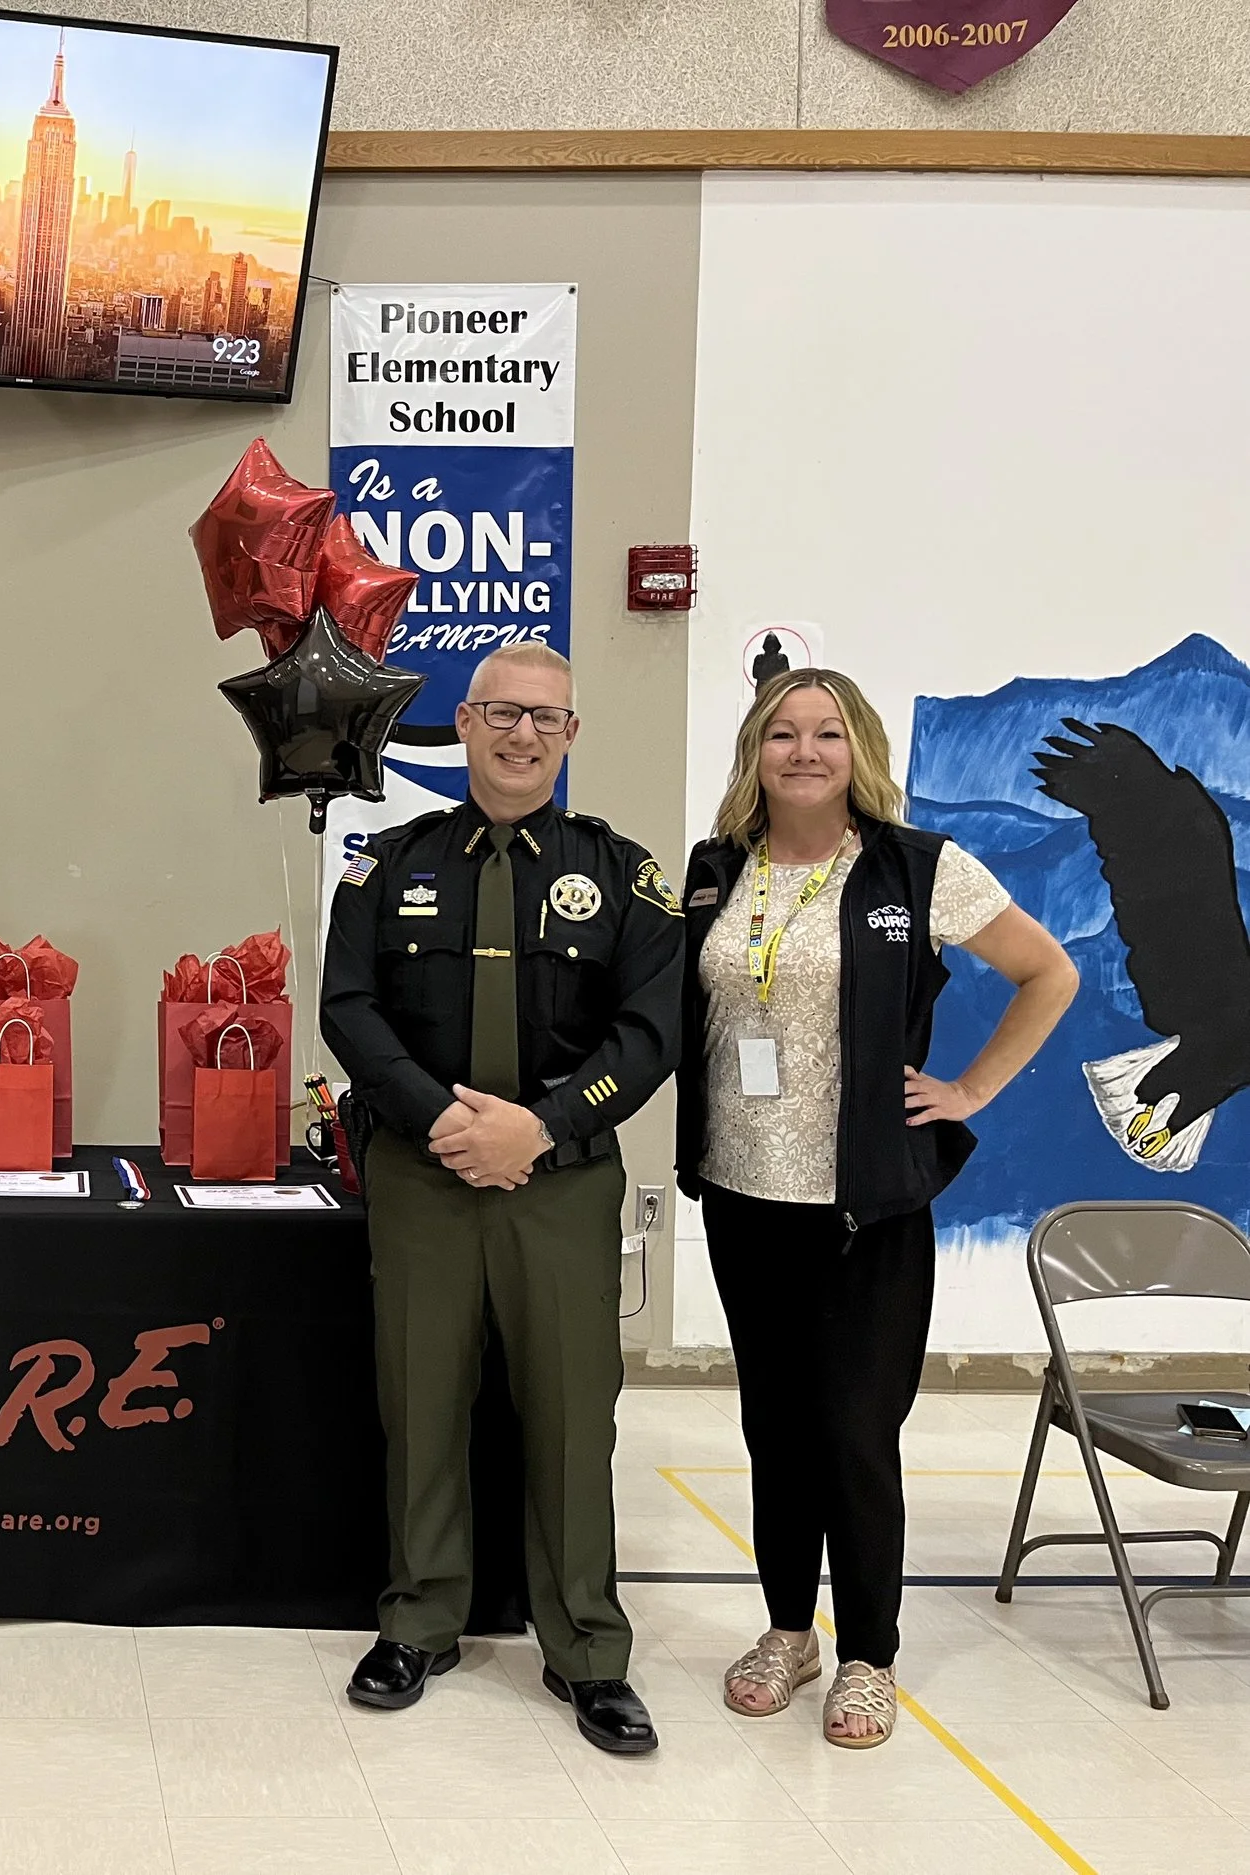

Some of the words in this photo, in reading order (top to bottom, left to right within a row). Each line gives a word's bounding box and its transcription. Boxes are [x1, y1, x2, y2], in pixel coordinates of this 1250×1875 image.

[882, 19, 1029, 48] 2006-2007
[380, 302, 528, 334] Pioneer
[212, 337, 261, 364] 9:23
[348, 351, 560, 391] Elementary
[389, 401, 515, 433] School
[348, 458, 396, 502] Is
[411, 477, 443, 502] a
[350, 510, 552, 573] NON-
[407, 581, 551, 613] LLYING
[650, 592, 674, 600] FIRE
[386, 624, 551, 653] CAMPUS
[636, 863, 657, 888] MASON
